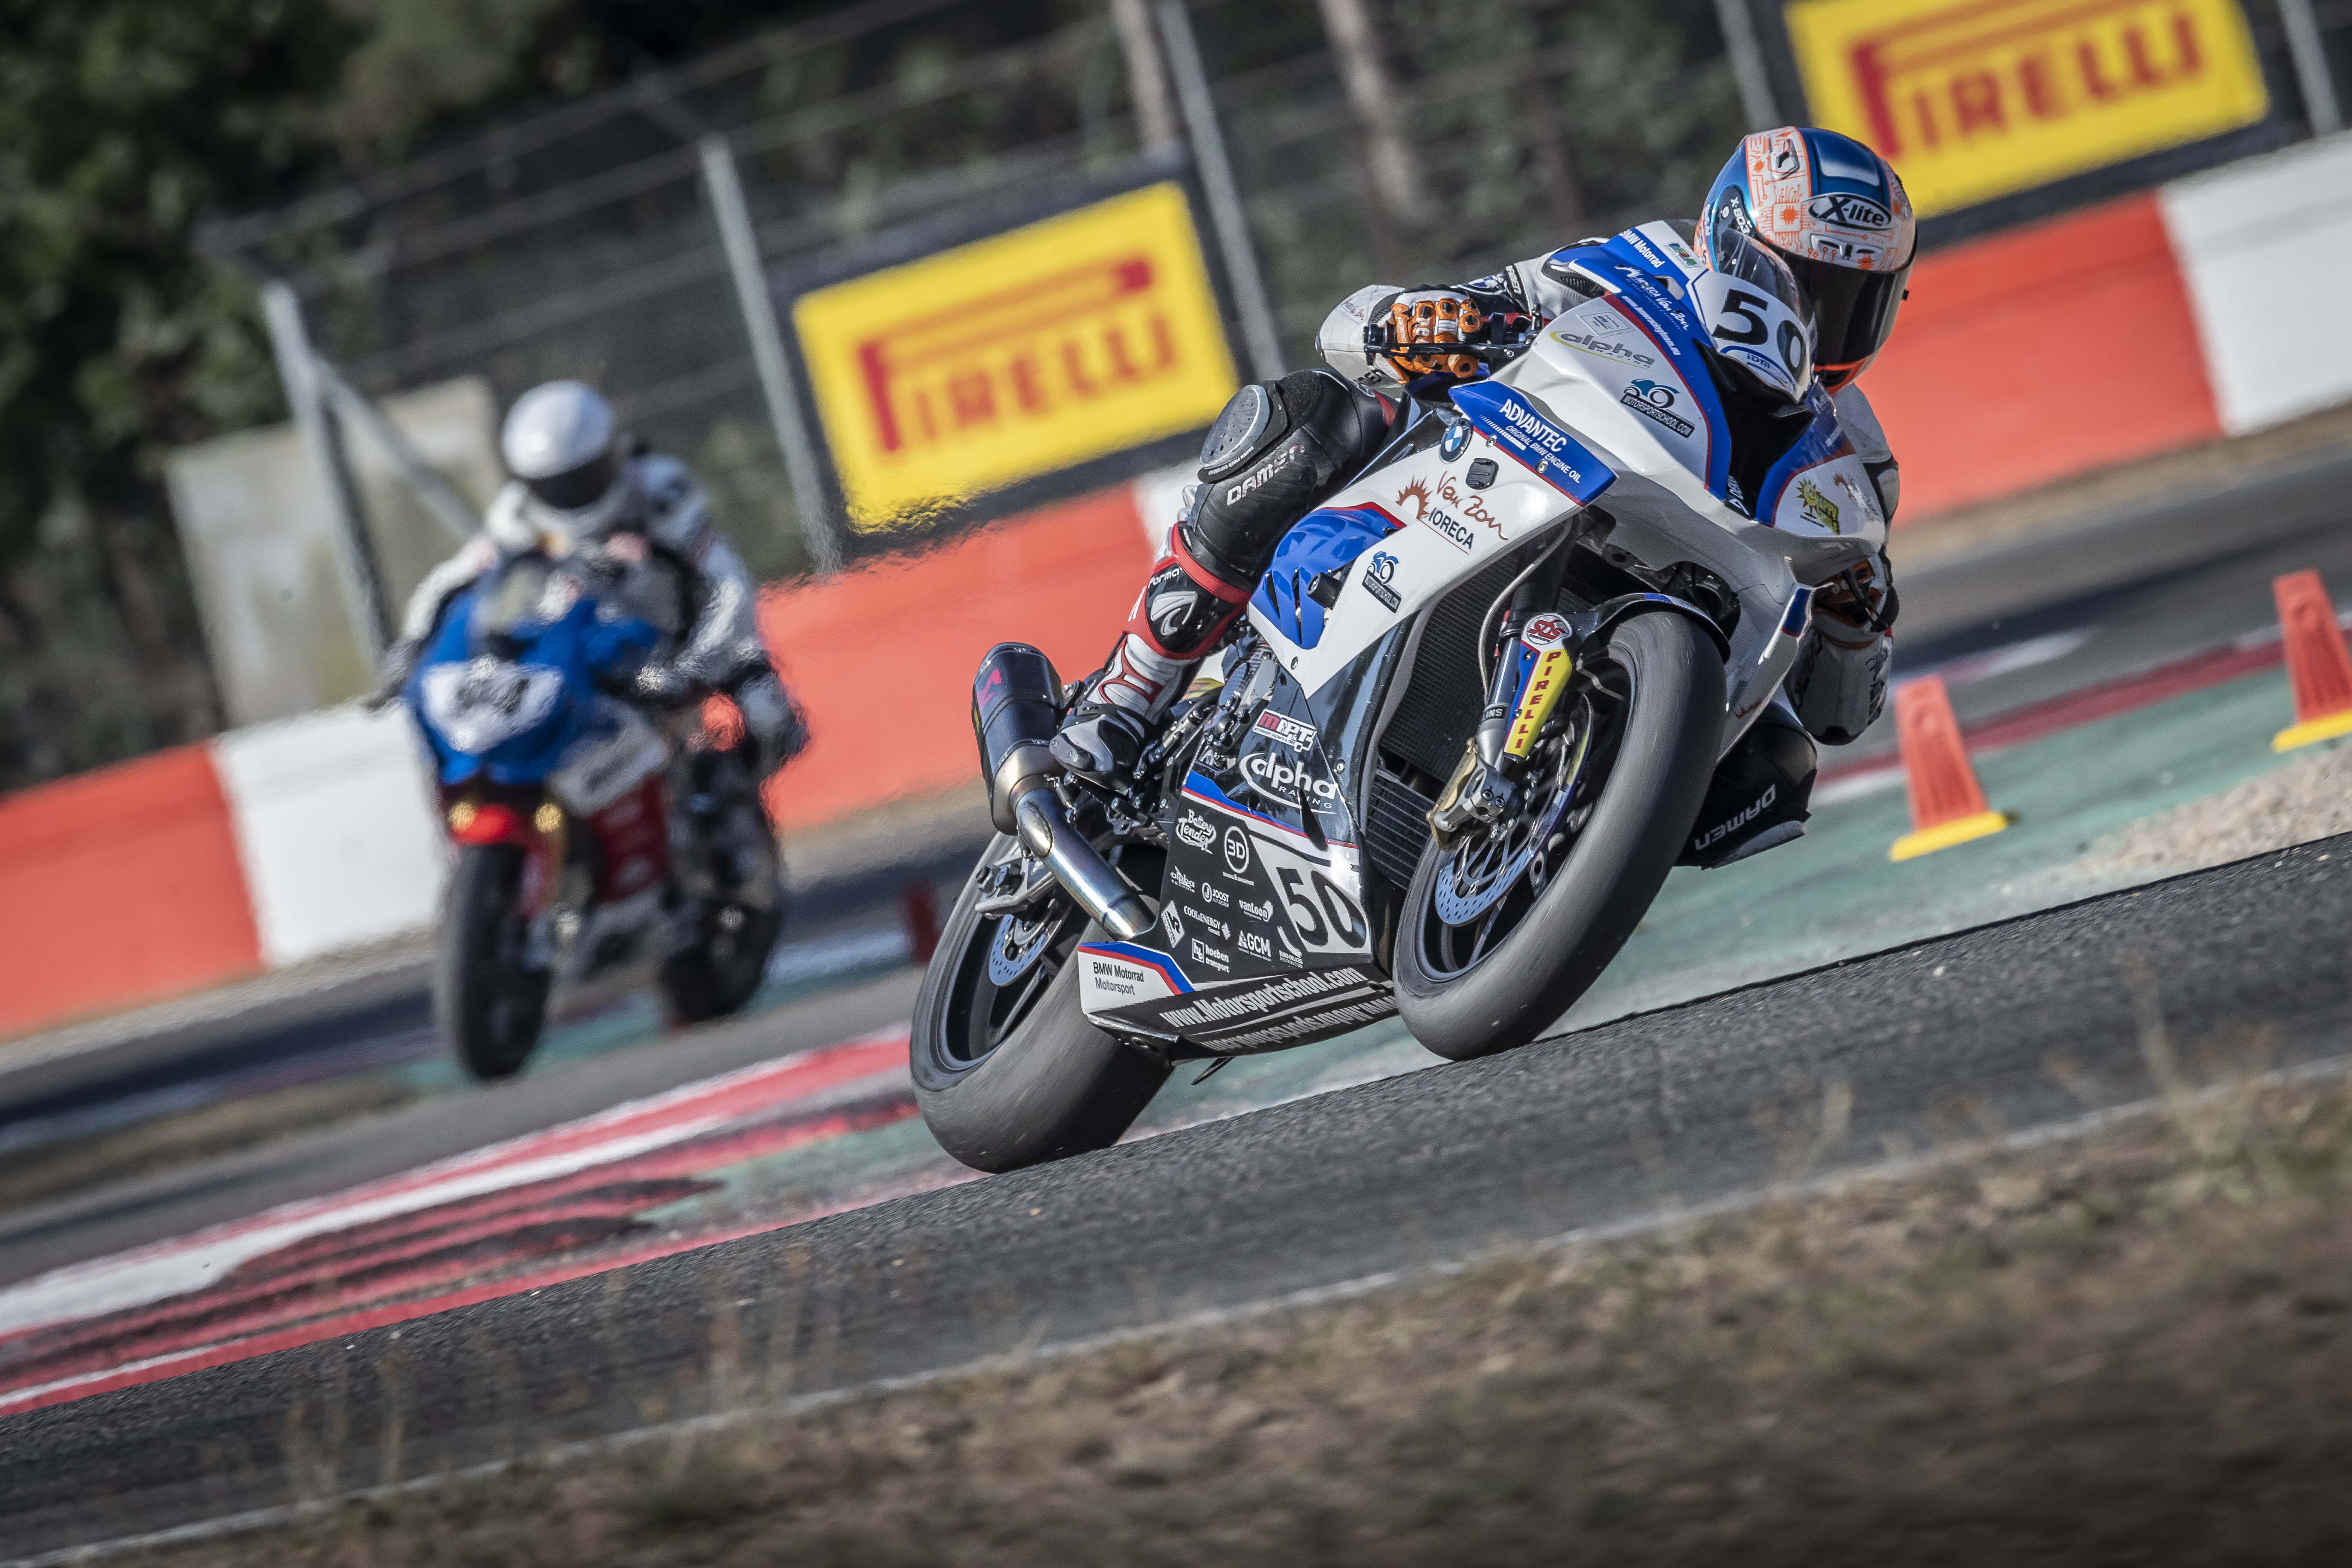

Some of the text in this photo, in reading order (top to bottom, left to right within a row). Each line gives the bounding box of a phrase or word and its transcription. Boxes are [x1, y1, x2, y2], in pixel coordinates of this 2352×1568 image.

[1846, 0, 2202, 161] PIRELLI
[1817, 196, 1884, 227] X-lite
[1634, 239, 1666, 269] Motorrad
[1561, 334, 1656, 366] alpha
[1712, 288, 1807, 383] 50
[853, 253, 1179, 453] PIRELLI
[1596, 349, 1651, 368] RACING
[1499, 398, 1568, 453] ADVANTEC
[1622, 394, 1693, 436] MOTORSPORTSCHOOL.COM
[1505, 425, 1581, 484] ORIGINAL BMW ENGINE OIL
[1436, 470, 1509, 541] Van Zon
[1515, 651, 1562, 749] PIRELLI
[1251, 752, 1337, 800] alpha
[1278, 786, 1333, 809] RAING
[1177, 817, 1209, 844] Tender
[1188, 808, 1215, 835] Battery
[1694, 783, 1776, 851] DAMEN
[1226, 838, 1246, 860] 3D
[1170, 869, 1195, 888] alpha
[1212, 888, 1229, 903] JOOST
[1275, 867, 1367, 949] 50
[1205, 943, 1230, 963] hoeben
[1205, 957, 1230, 973] transport
[1093, 961, 1145, 983] BMW Motorrad
[1094, 976, 1135, 996] Motorsport
[1159, 967, 1369, 1028] www.Motorsportschool.com
